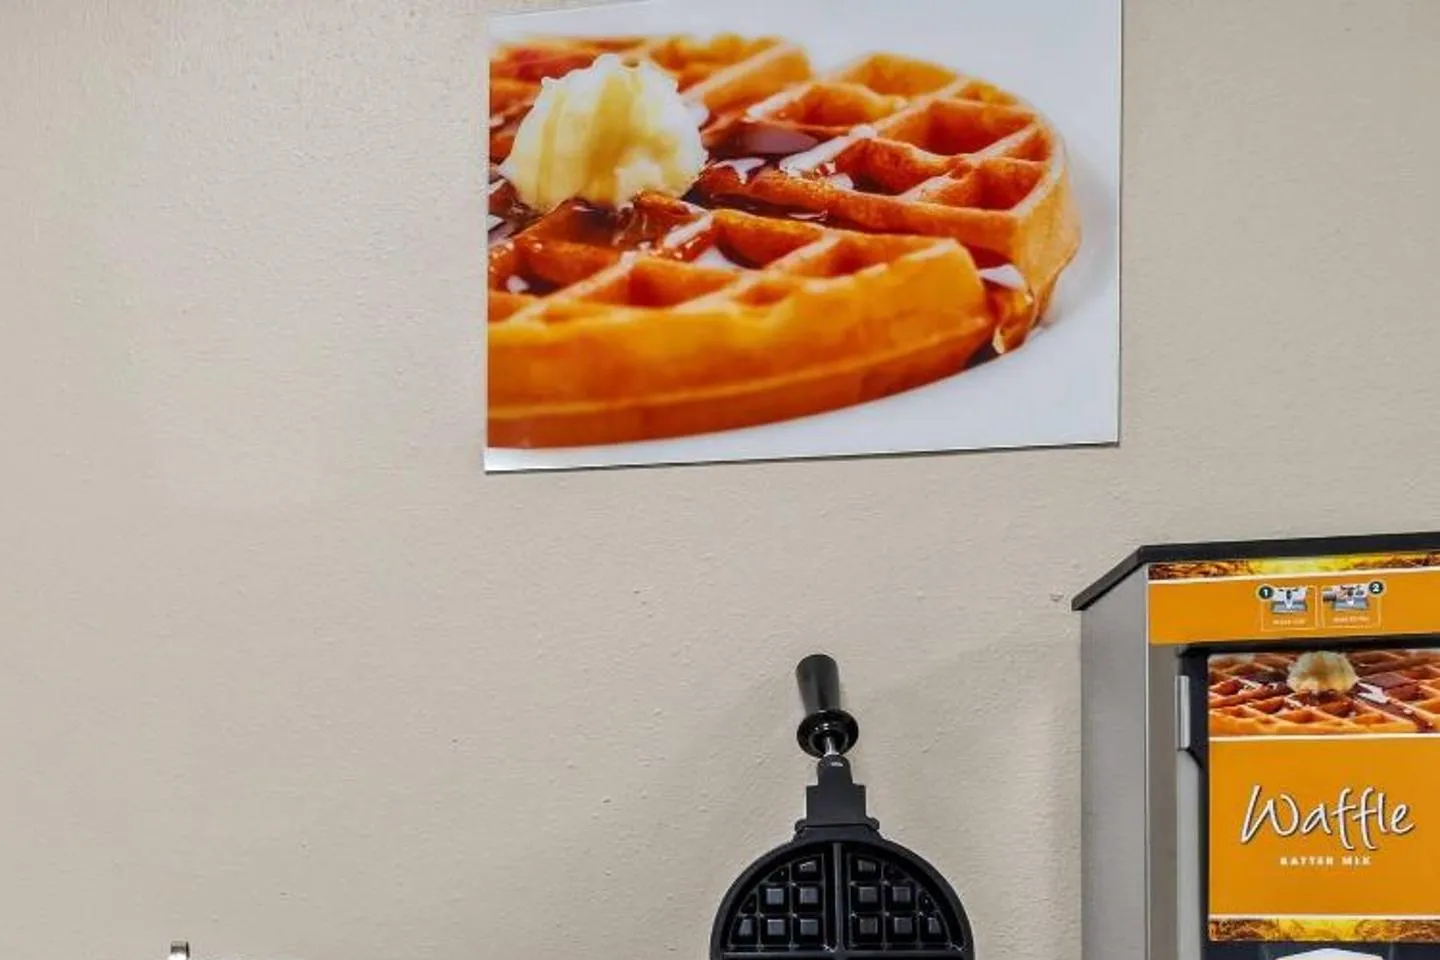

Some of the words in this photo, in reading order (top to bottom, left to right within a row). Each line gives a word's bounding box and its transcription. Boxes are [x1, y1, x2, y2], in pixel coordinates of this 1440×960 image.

[1240, 784, 1417, 851] Waffle
[1280, 855, 1334, 866] BATTER
[1341, 855, 1373, 866] MIX
